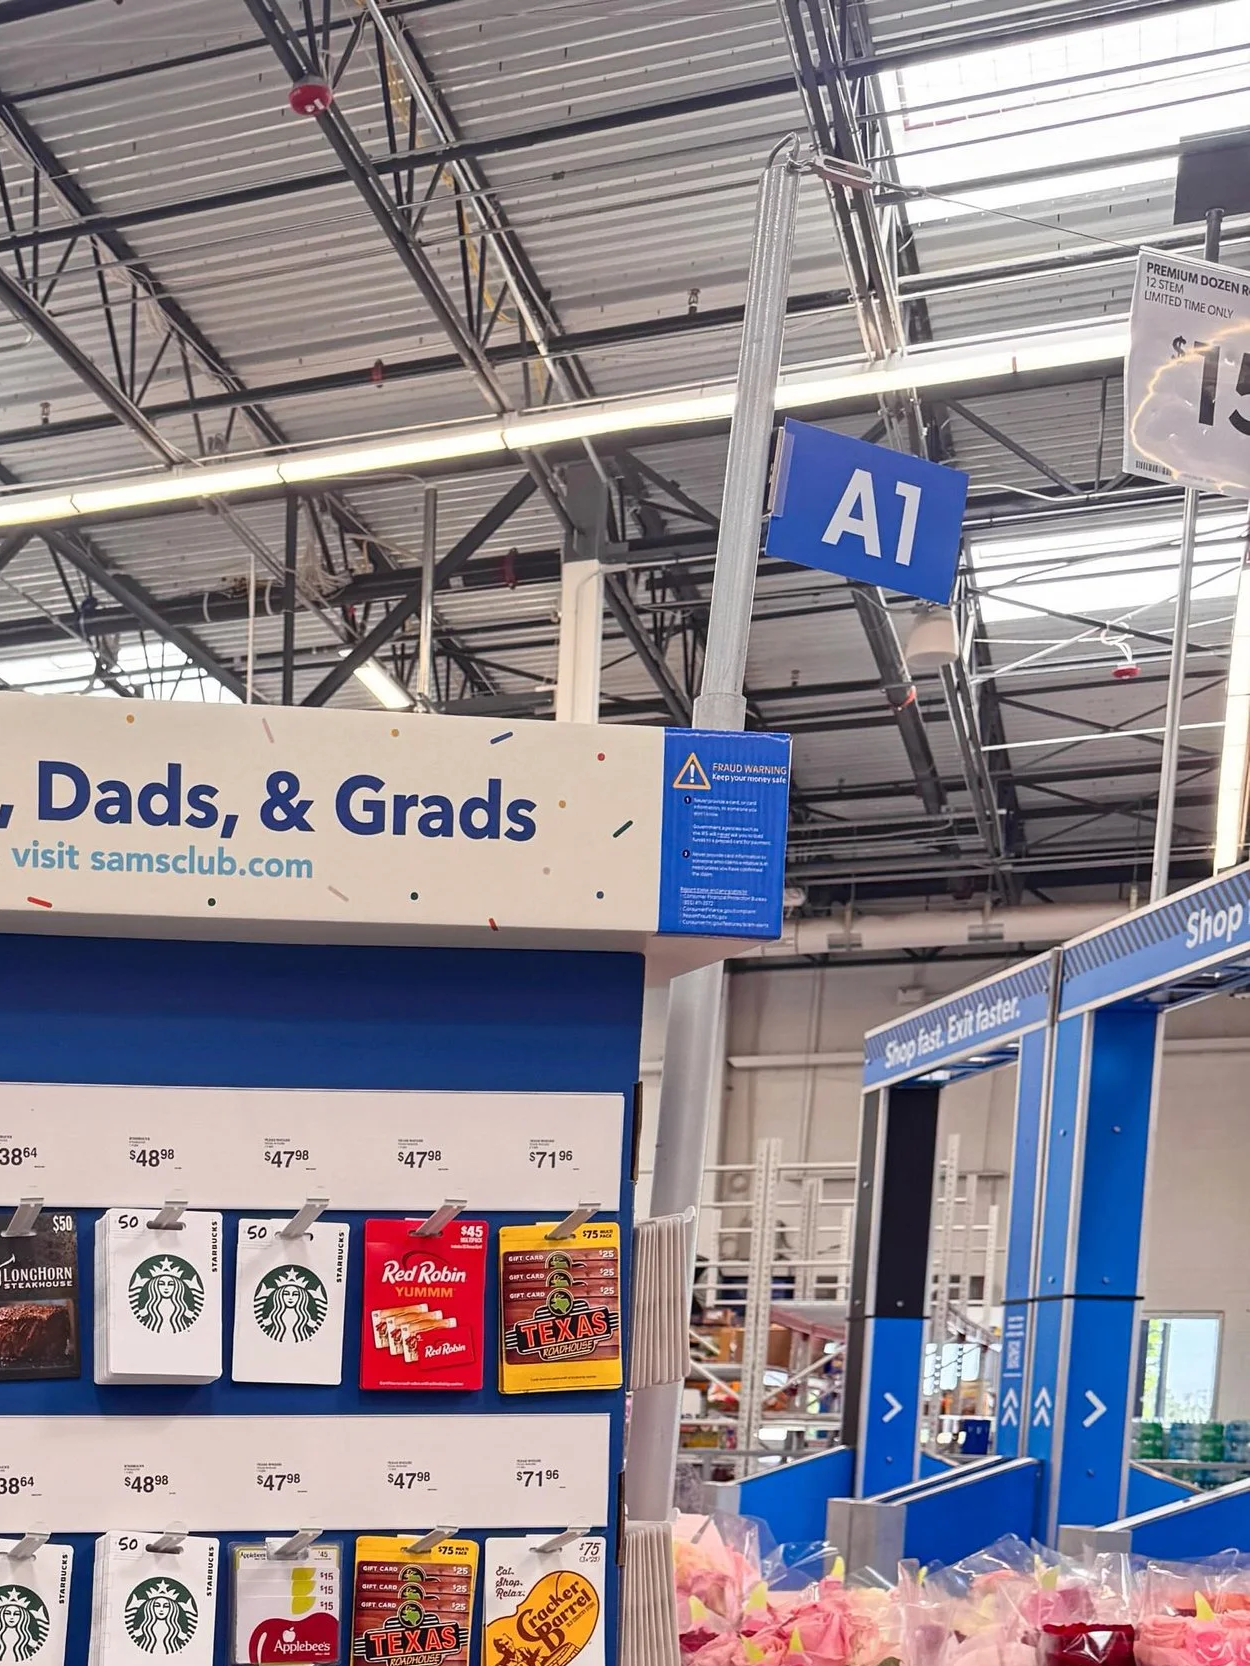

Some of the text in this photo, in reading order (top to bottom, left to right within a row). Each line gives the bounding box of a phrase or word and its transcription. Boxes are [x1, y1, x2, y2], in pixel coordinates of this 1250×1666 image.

[1145, 276, 1184, 294] 12 STEM
[1147, 262, 1198, 285] PREMIUM
[1200, 272, 1239, 294] DOZEN
[1144, 291, 1234, 319] LIMITED TIME ONLY
[821, 467, 922, 566] A1
[713, 763, 787, 775] FRAUD WARNING
[712, 773, 787, 784] Keep your money safe
[38, 760, 239, 838] Dads,
[259, 771, 316, 833] &
[335, 775, 537, 840] Grads
[12, 839, 80, 870] visit
[91, 847, 314, 879] samsclub.com
[1186, 902, 1243, 949] Shop
[884, 997, 1021, 1069] Shop fast. Exit faster.
[52, 1216, 72, 1232] $50
[118, 1215, 139, 1230] 50
[460, 1226, 484, 1237] $45
[582, 1229, 598, 1240] $75
[508, 1253, 544, 1262] GIFT CARD
[599, 1249, 614, 1259] $25
[4, 1266, 73, 1282] LONGHORN
[382, 1260, 466, 1283] Red Robin
[4, 1281, 73, 1290] STEAKHOUSE
[395, 1286, 454, 1298] YUMMM
[521, 1311, 607, 1346] TEXAS
[543, 1339, 593, 1359] ROADHOUSE
[579, 1542, 601, 1556] $75
[320, 1571, 333, 1581] $15
[495, 1565, 514, 1577] Eat.
[495, 1576, 523, 1589] Shop.
[495, 1587, 525, 1599] Relax.
[517, 1580, 580, 1643] Cracker
[534, 1593, 592, 1653] Barrel
[273, 1638, 331, 1654] Applebee's
